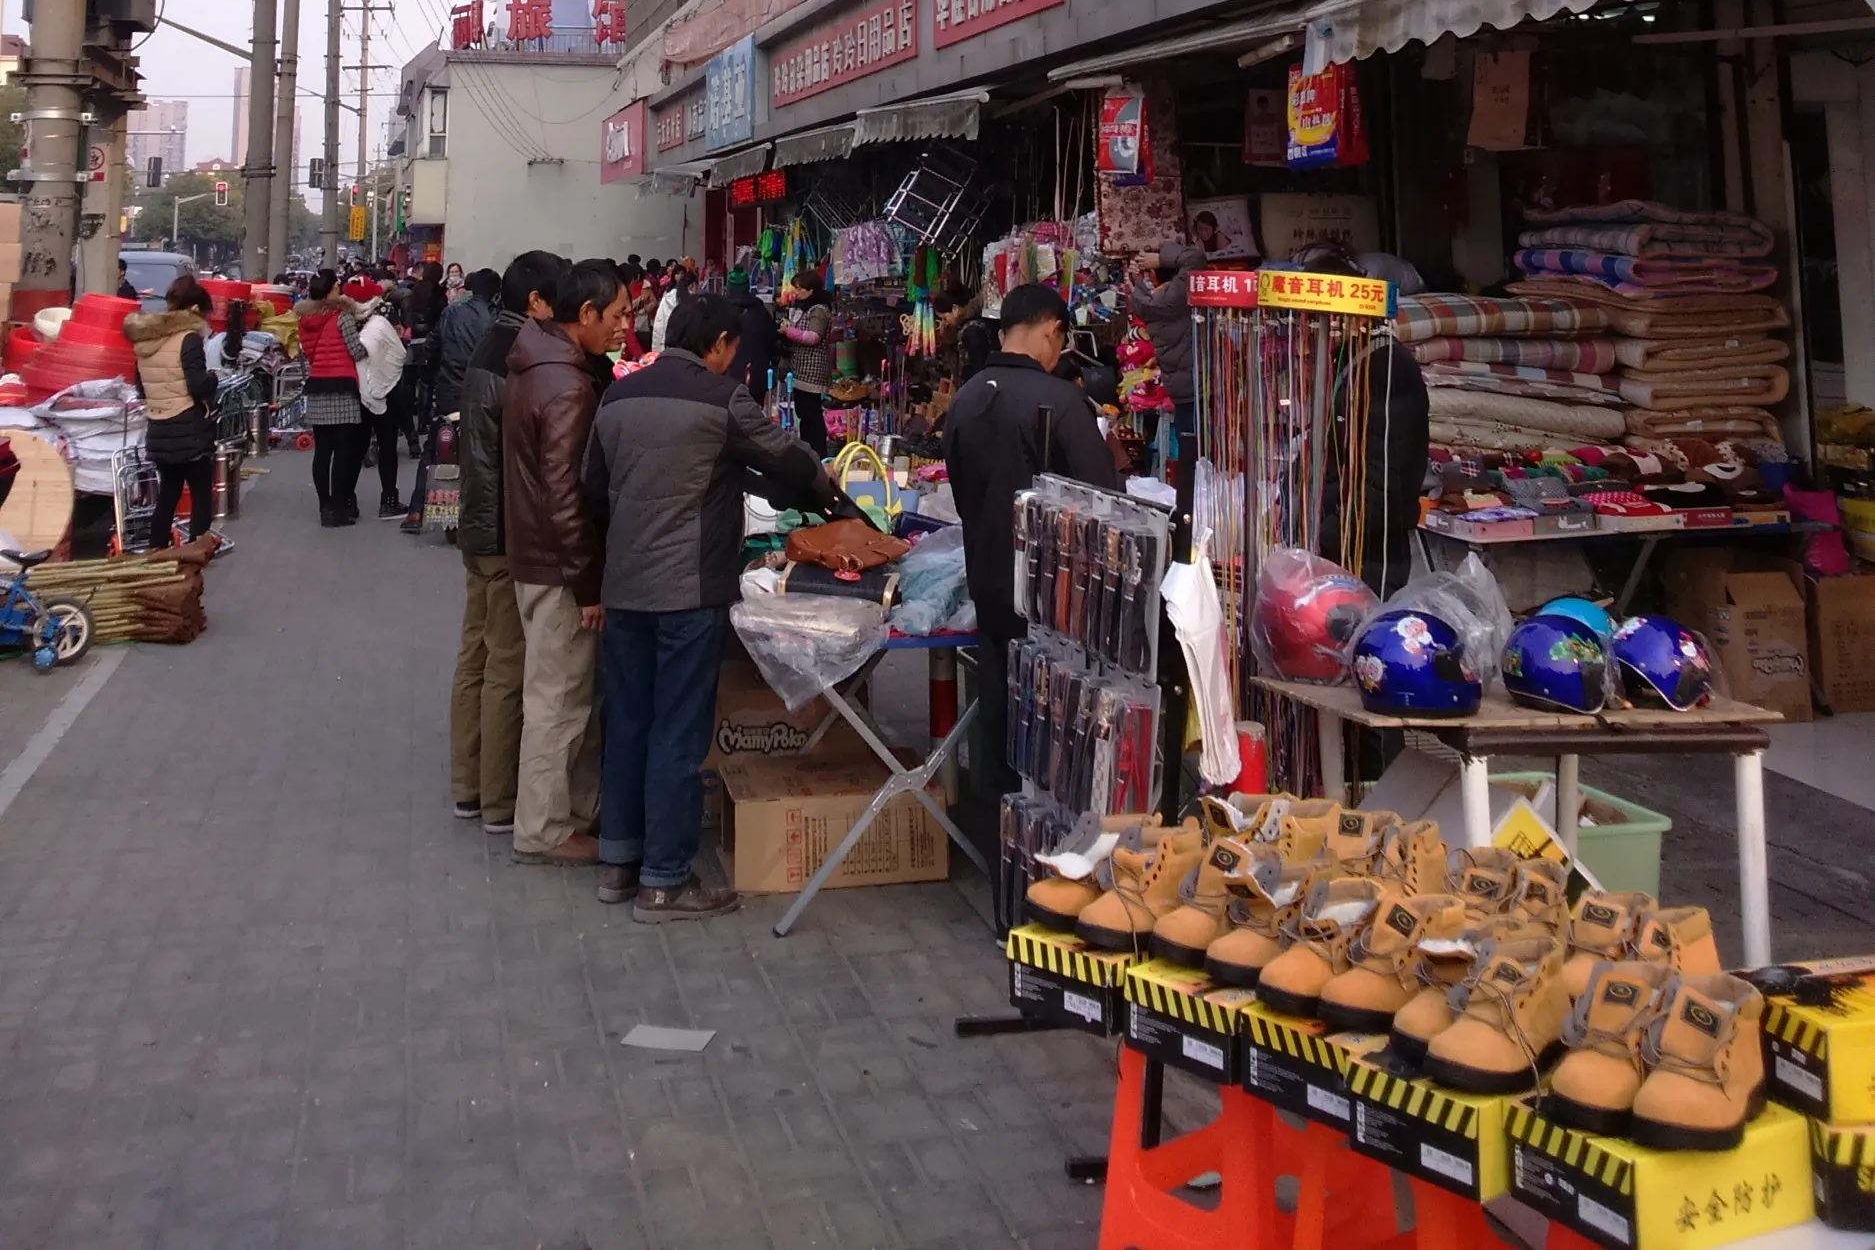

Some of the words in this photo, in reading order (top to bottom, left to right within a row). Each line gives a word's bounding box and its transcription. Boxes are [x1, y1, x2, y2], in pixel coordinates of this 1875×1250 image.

[1271, 275, 1345, 299] 魔音耳机
[1350, 284, 1384, 303] 25元
[716, 718, 809, 755] MamyPoko
[1675, 1171, 1783, 1234] 安全防护
